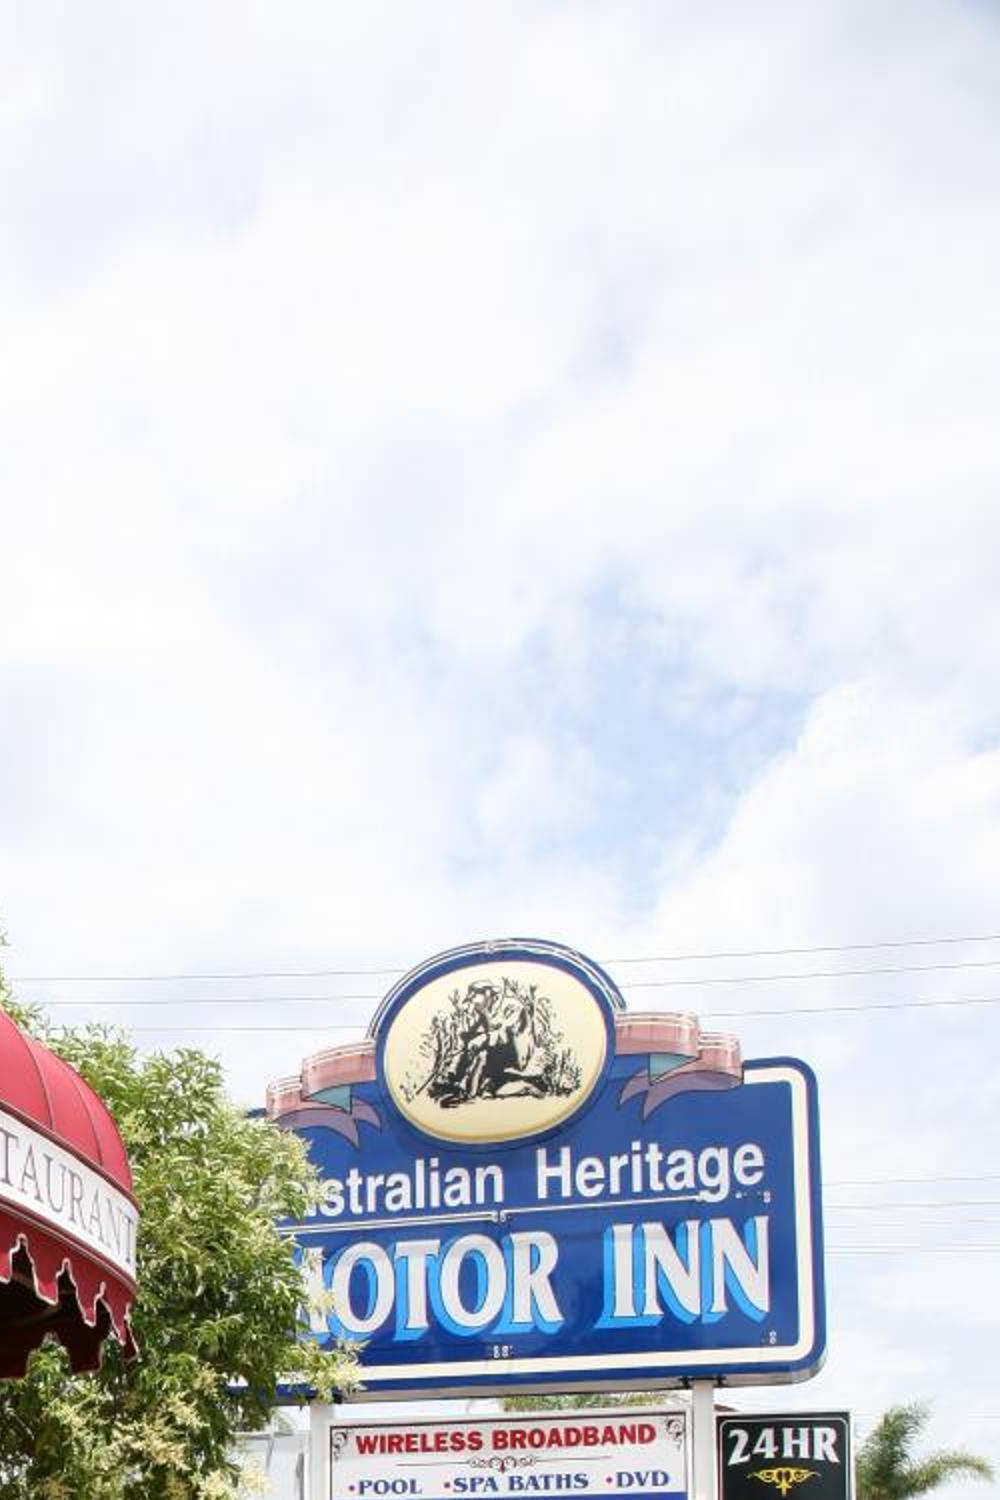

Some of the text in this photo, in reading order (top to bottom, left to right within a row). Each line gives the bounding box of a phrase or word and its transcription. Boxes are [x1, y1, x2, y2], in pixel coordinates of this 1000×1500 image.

[535, 1143, 765, 1203] Heritage
[610, 1216, 771, 1319] INN
[356, 1423, 657, 1455] WIRELESS BROADBAND
[727, 1427, 841, 1467] 24HR
[358, 1471, 670, 1496] POOL SPA BATHS DVD
